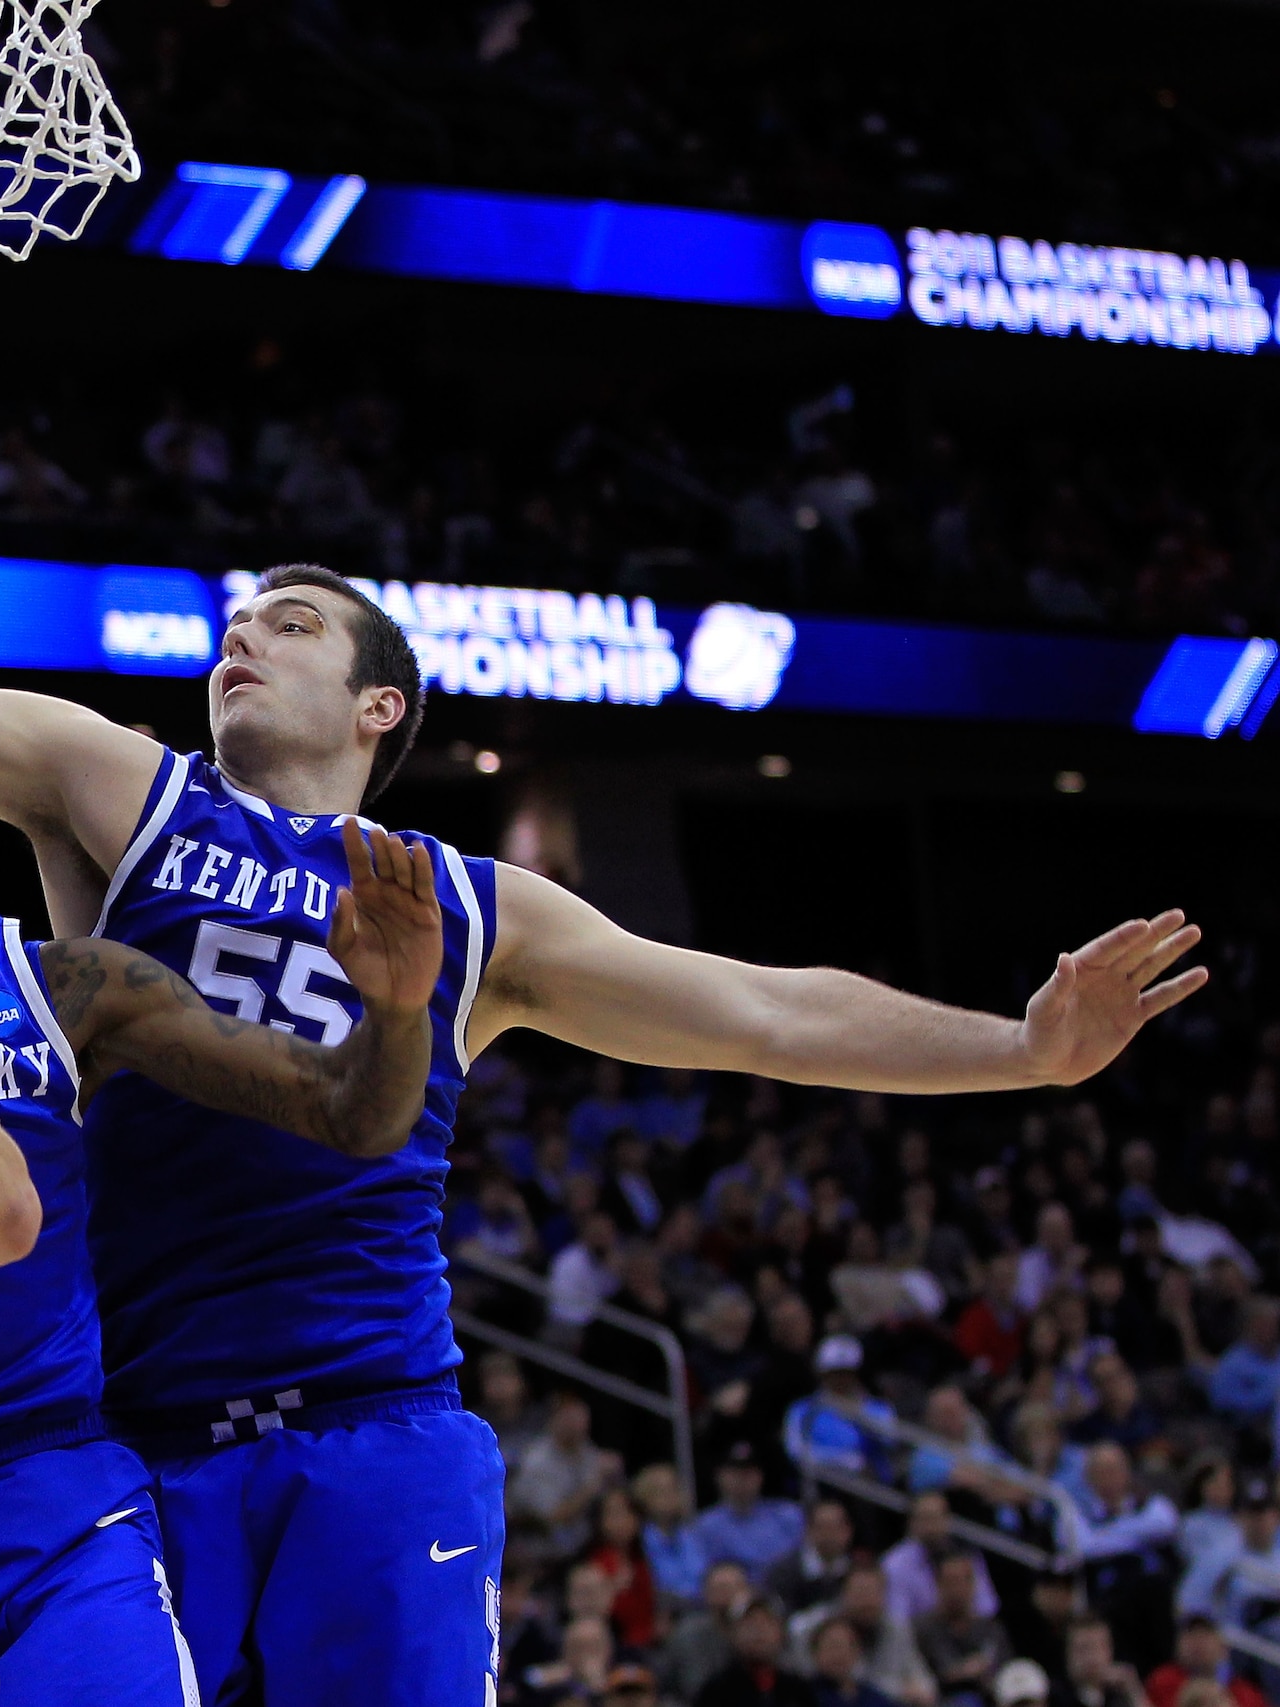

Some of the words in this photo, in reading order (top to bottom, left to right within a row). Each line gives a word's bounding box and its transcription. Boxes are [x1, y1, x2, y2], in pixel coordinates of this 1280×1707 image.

[906, 227, 996, 280] 2011
[997, 235, 1265, 306] BASKETBALL
[908, 273, 1272, 355] CHAMPIONSHIP
[342, 576, 674, 648] ASKETBALL
[408, 632, 683, 706] PIONSHIP
[152, 834, 330, 920] KENTU
[187, 919, 353, 1047] 55
